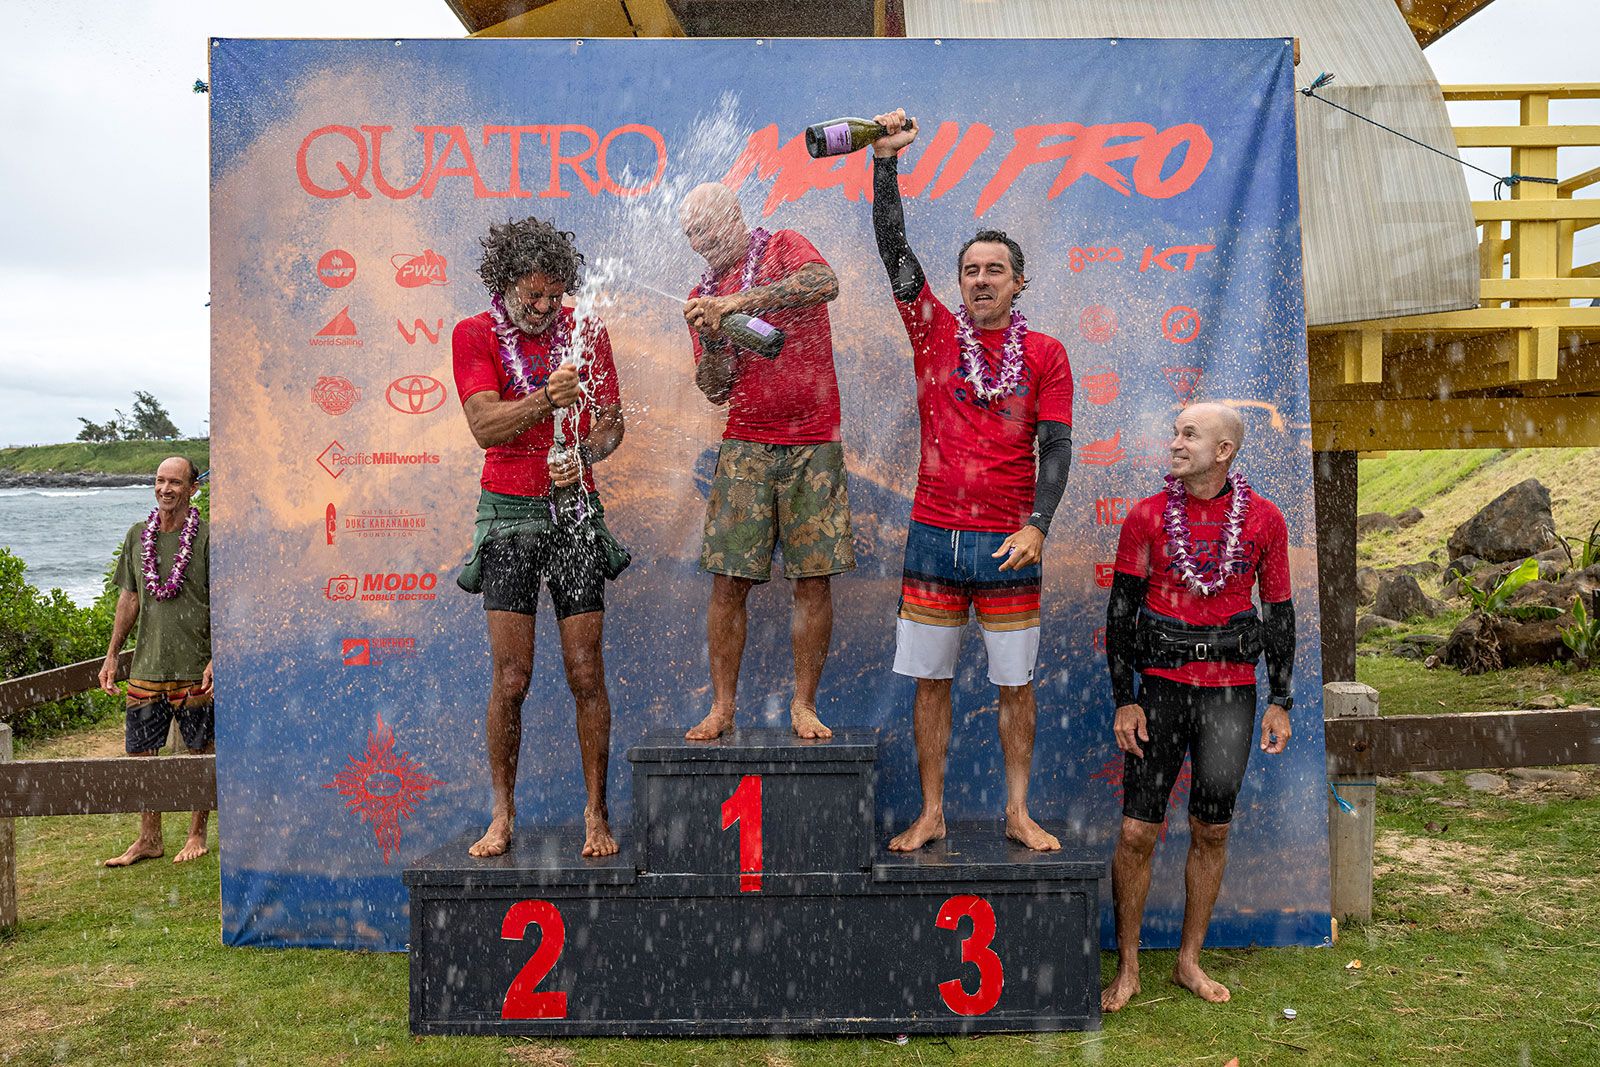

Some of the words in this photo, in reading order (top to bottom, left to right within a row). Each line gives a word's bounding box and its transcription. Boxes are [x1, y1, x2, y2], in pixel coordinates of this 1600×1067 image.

[296, 124, 667, 199] QUATRO
[974, 122, 1214, 218] PRO
[1138, 244, 1217, 272] KT
[402, 264, 441, 277] PWA
[312, 387, 361, 401] MANA
[345, 519, 366, 529] DUKE
[362, 573, 438, 592] MODO
[361, 593, 396, 601] MOBILE
[397, 593, 437, 601] DOCTOR
[721, 775, 763, 892] 1
[500, 900, 568, 1020] 2
[935, 894, 1004, 1016] 3
